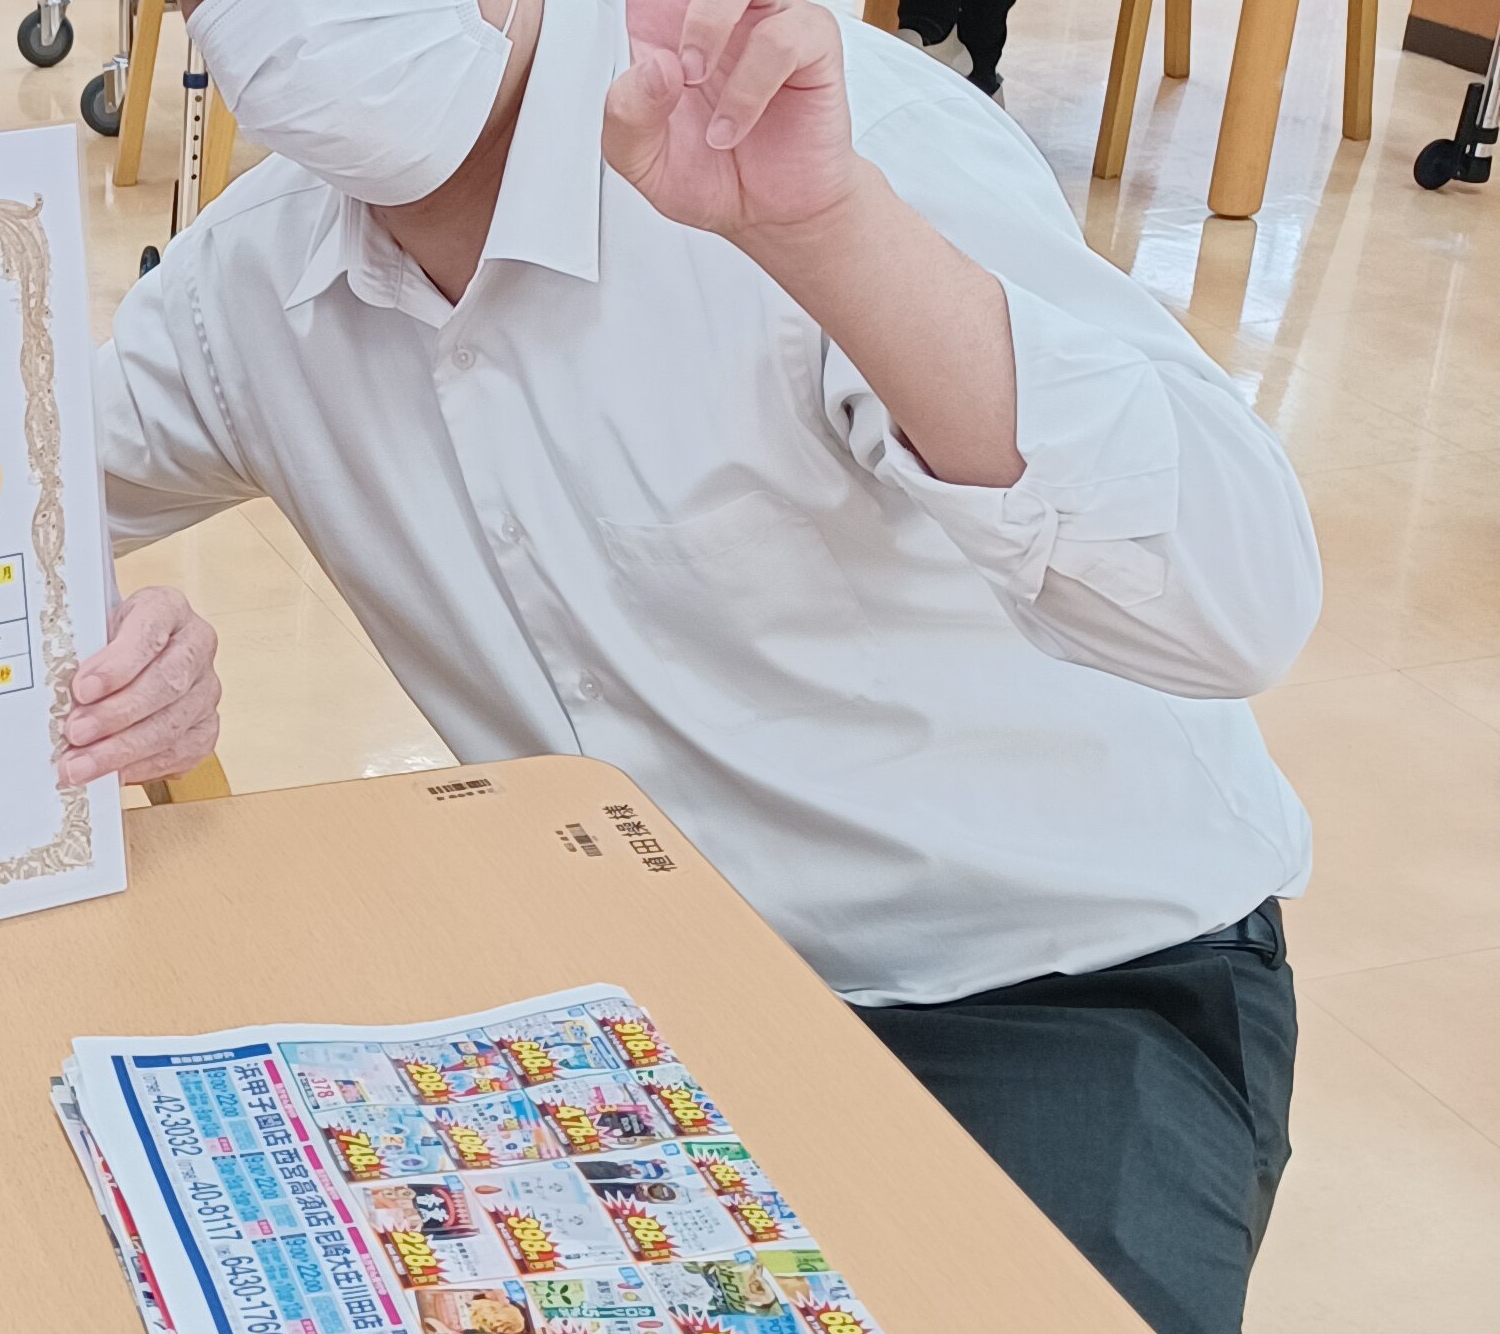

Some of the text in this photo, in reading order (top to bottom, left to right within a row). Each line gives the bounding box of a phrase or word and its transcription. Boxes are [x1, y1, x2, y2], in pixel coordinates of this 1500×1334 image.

[229, 1062, 296, 1147] 浜甲子園店
[269, 1147, 336, 1228] 西宮高須店
